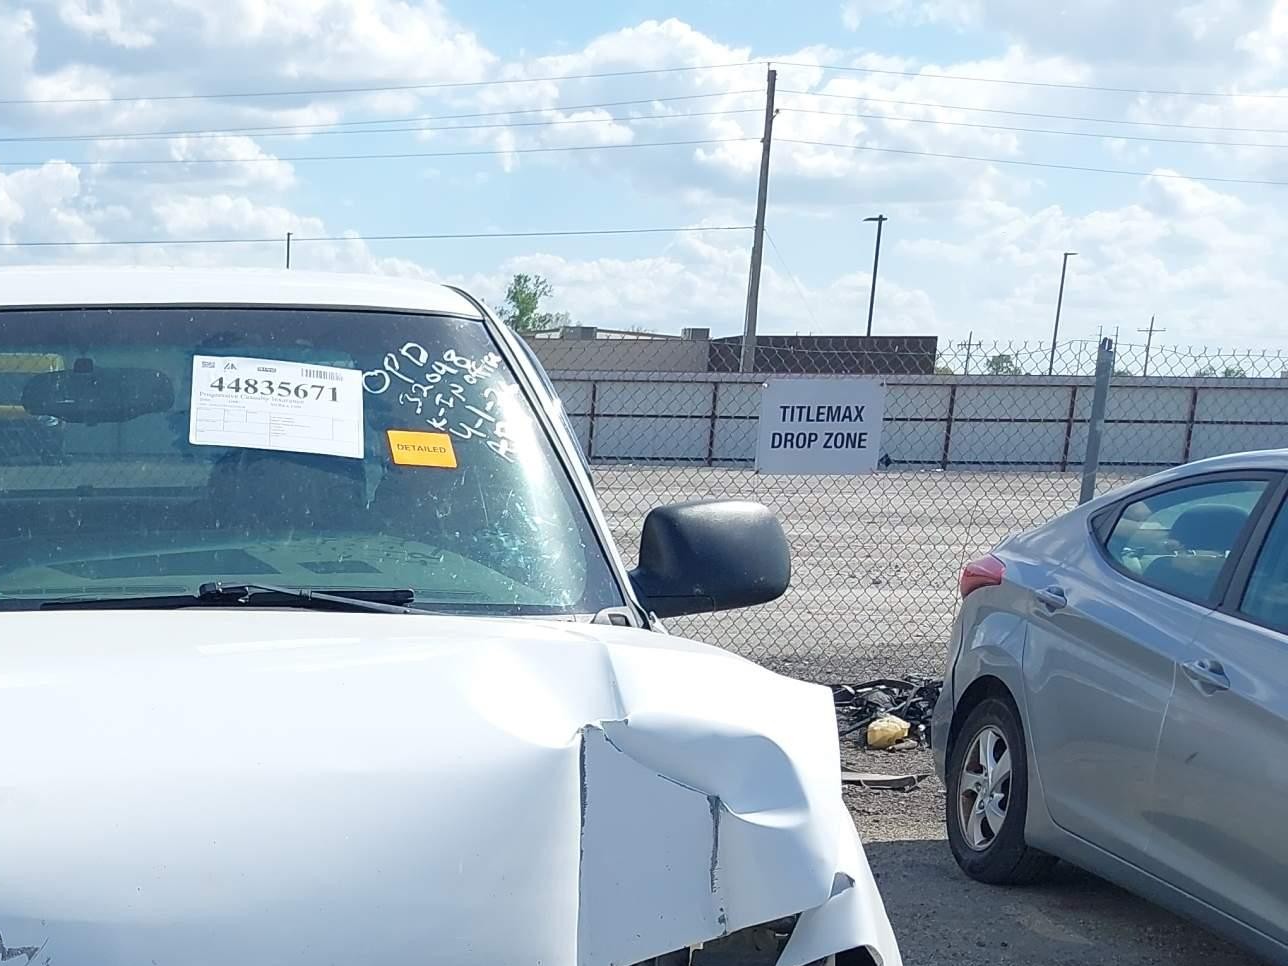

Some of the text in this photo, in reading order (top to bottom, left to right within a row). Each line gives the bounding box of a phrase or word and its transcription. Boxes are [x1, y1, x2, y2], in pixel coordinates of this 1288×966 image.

[362, 342, 429, 394] OPD
[209, 376, 339, 402] 44835671
[399, 349, 472, 415] 32048
[779, 405, 865, 423] TITLEMAX
[396, 443, 447, 454] DETAILED
[770, 432, 868, 449] DROP ZONE
